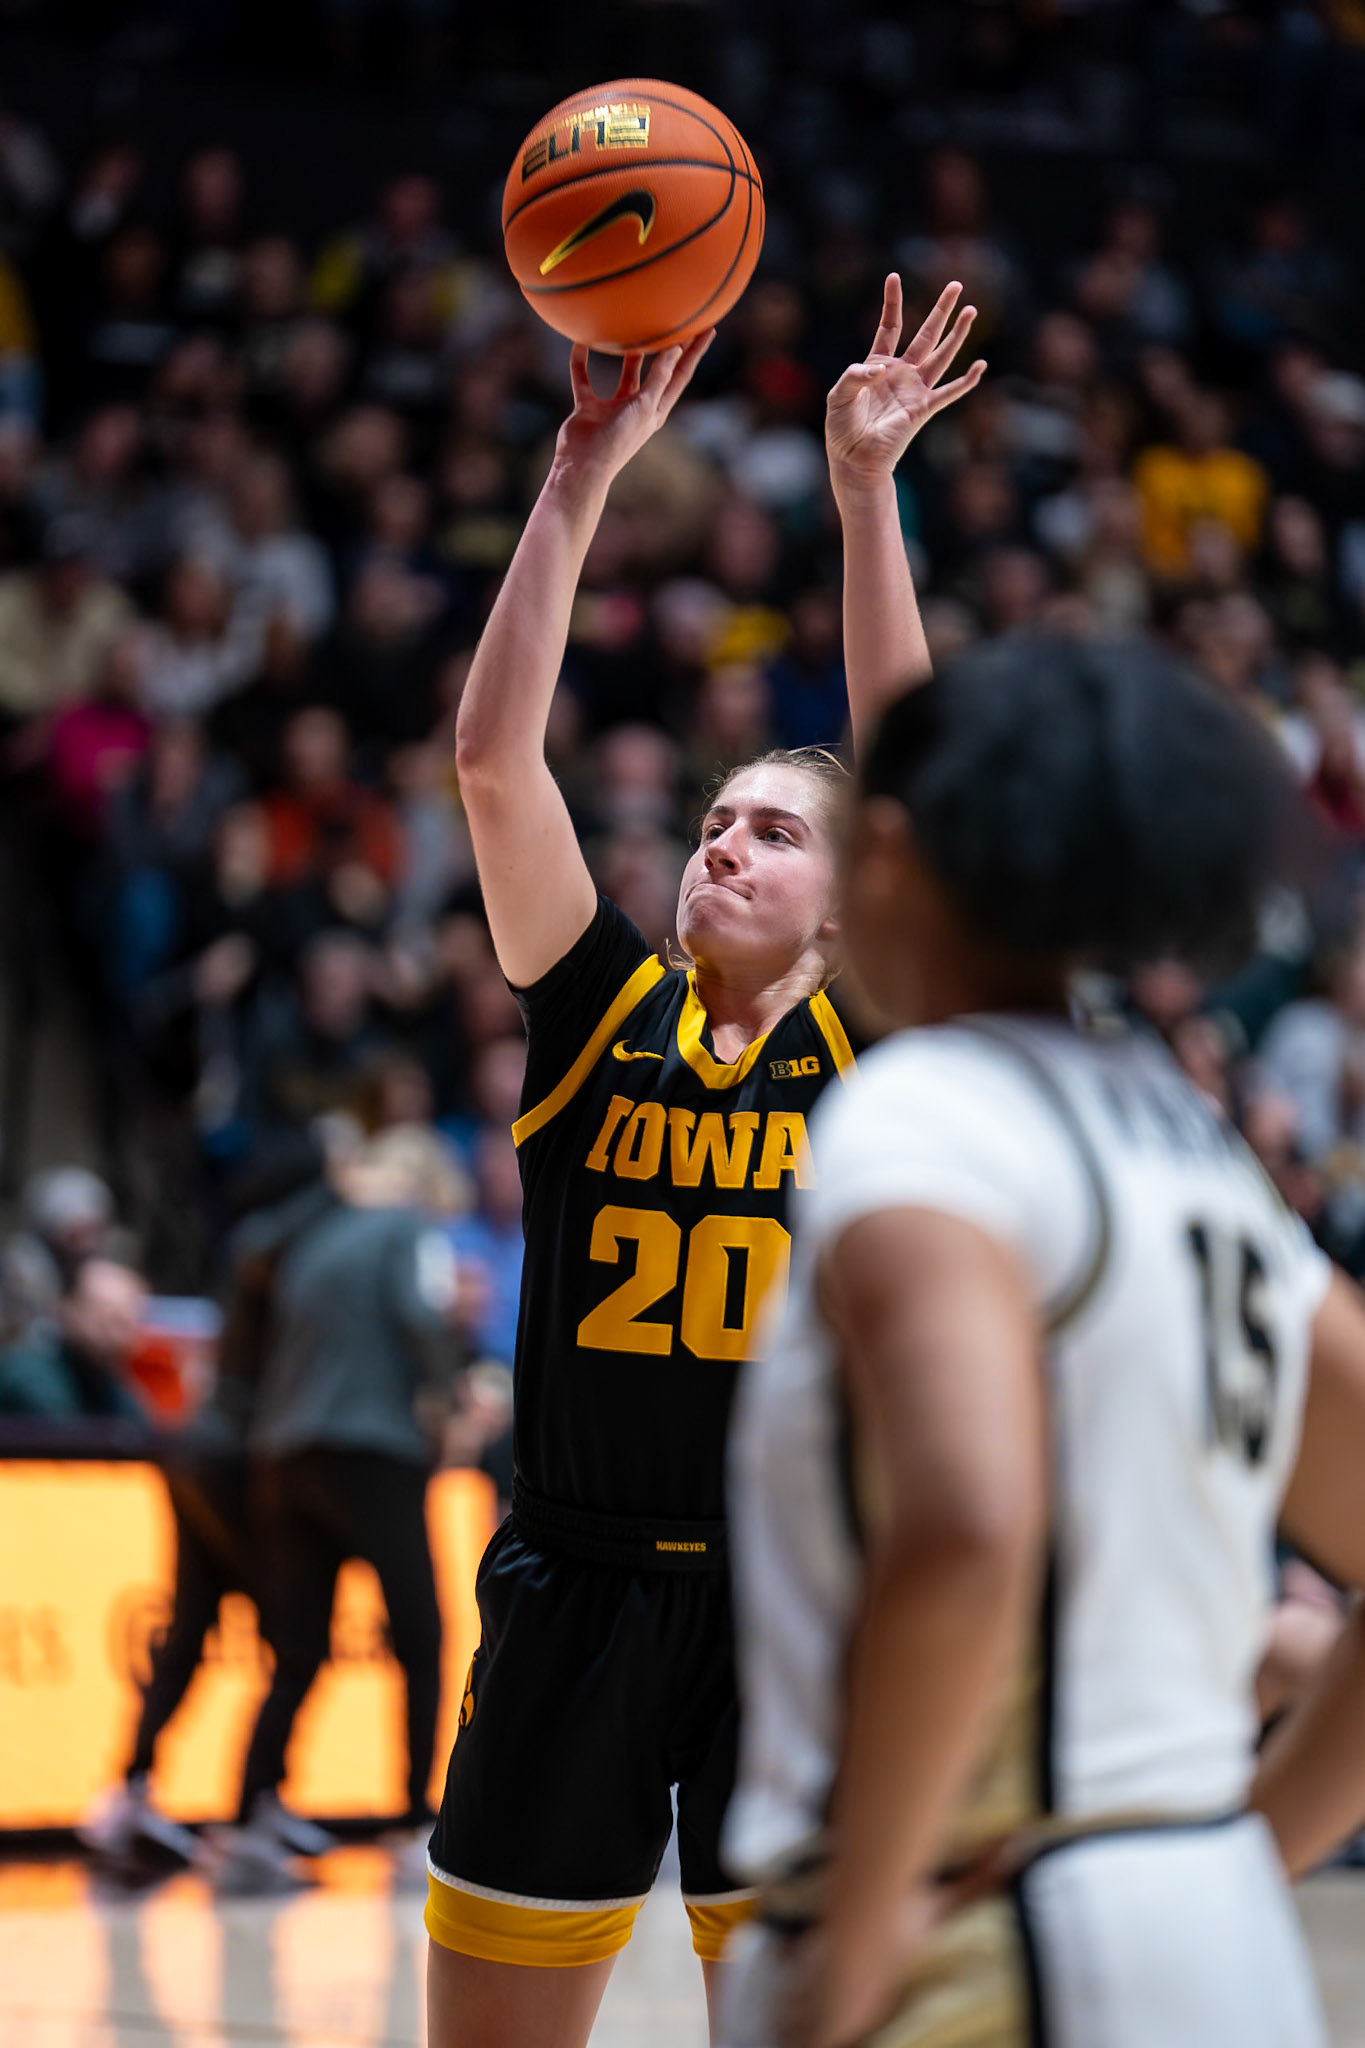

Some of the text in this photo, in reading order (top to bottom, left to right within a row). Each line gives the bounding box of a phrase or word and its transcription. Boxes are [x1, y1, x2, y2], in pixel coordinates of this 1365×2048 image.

[585, 1095, 816, 1190] IOWA
[577, 1204, 791, 1362] 20
[656, 1541, 706, 1552] HAWKEYES
